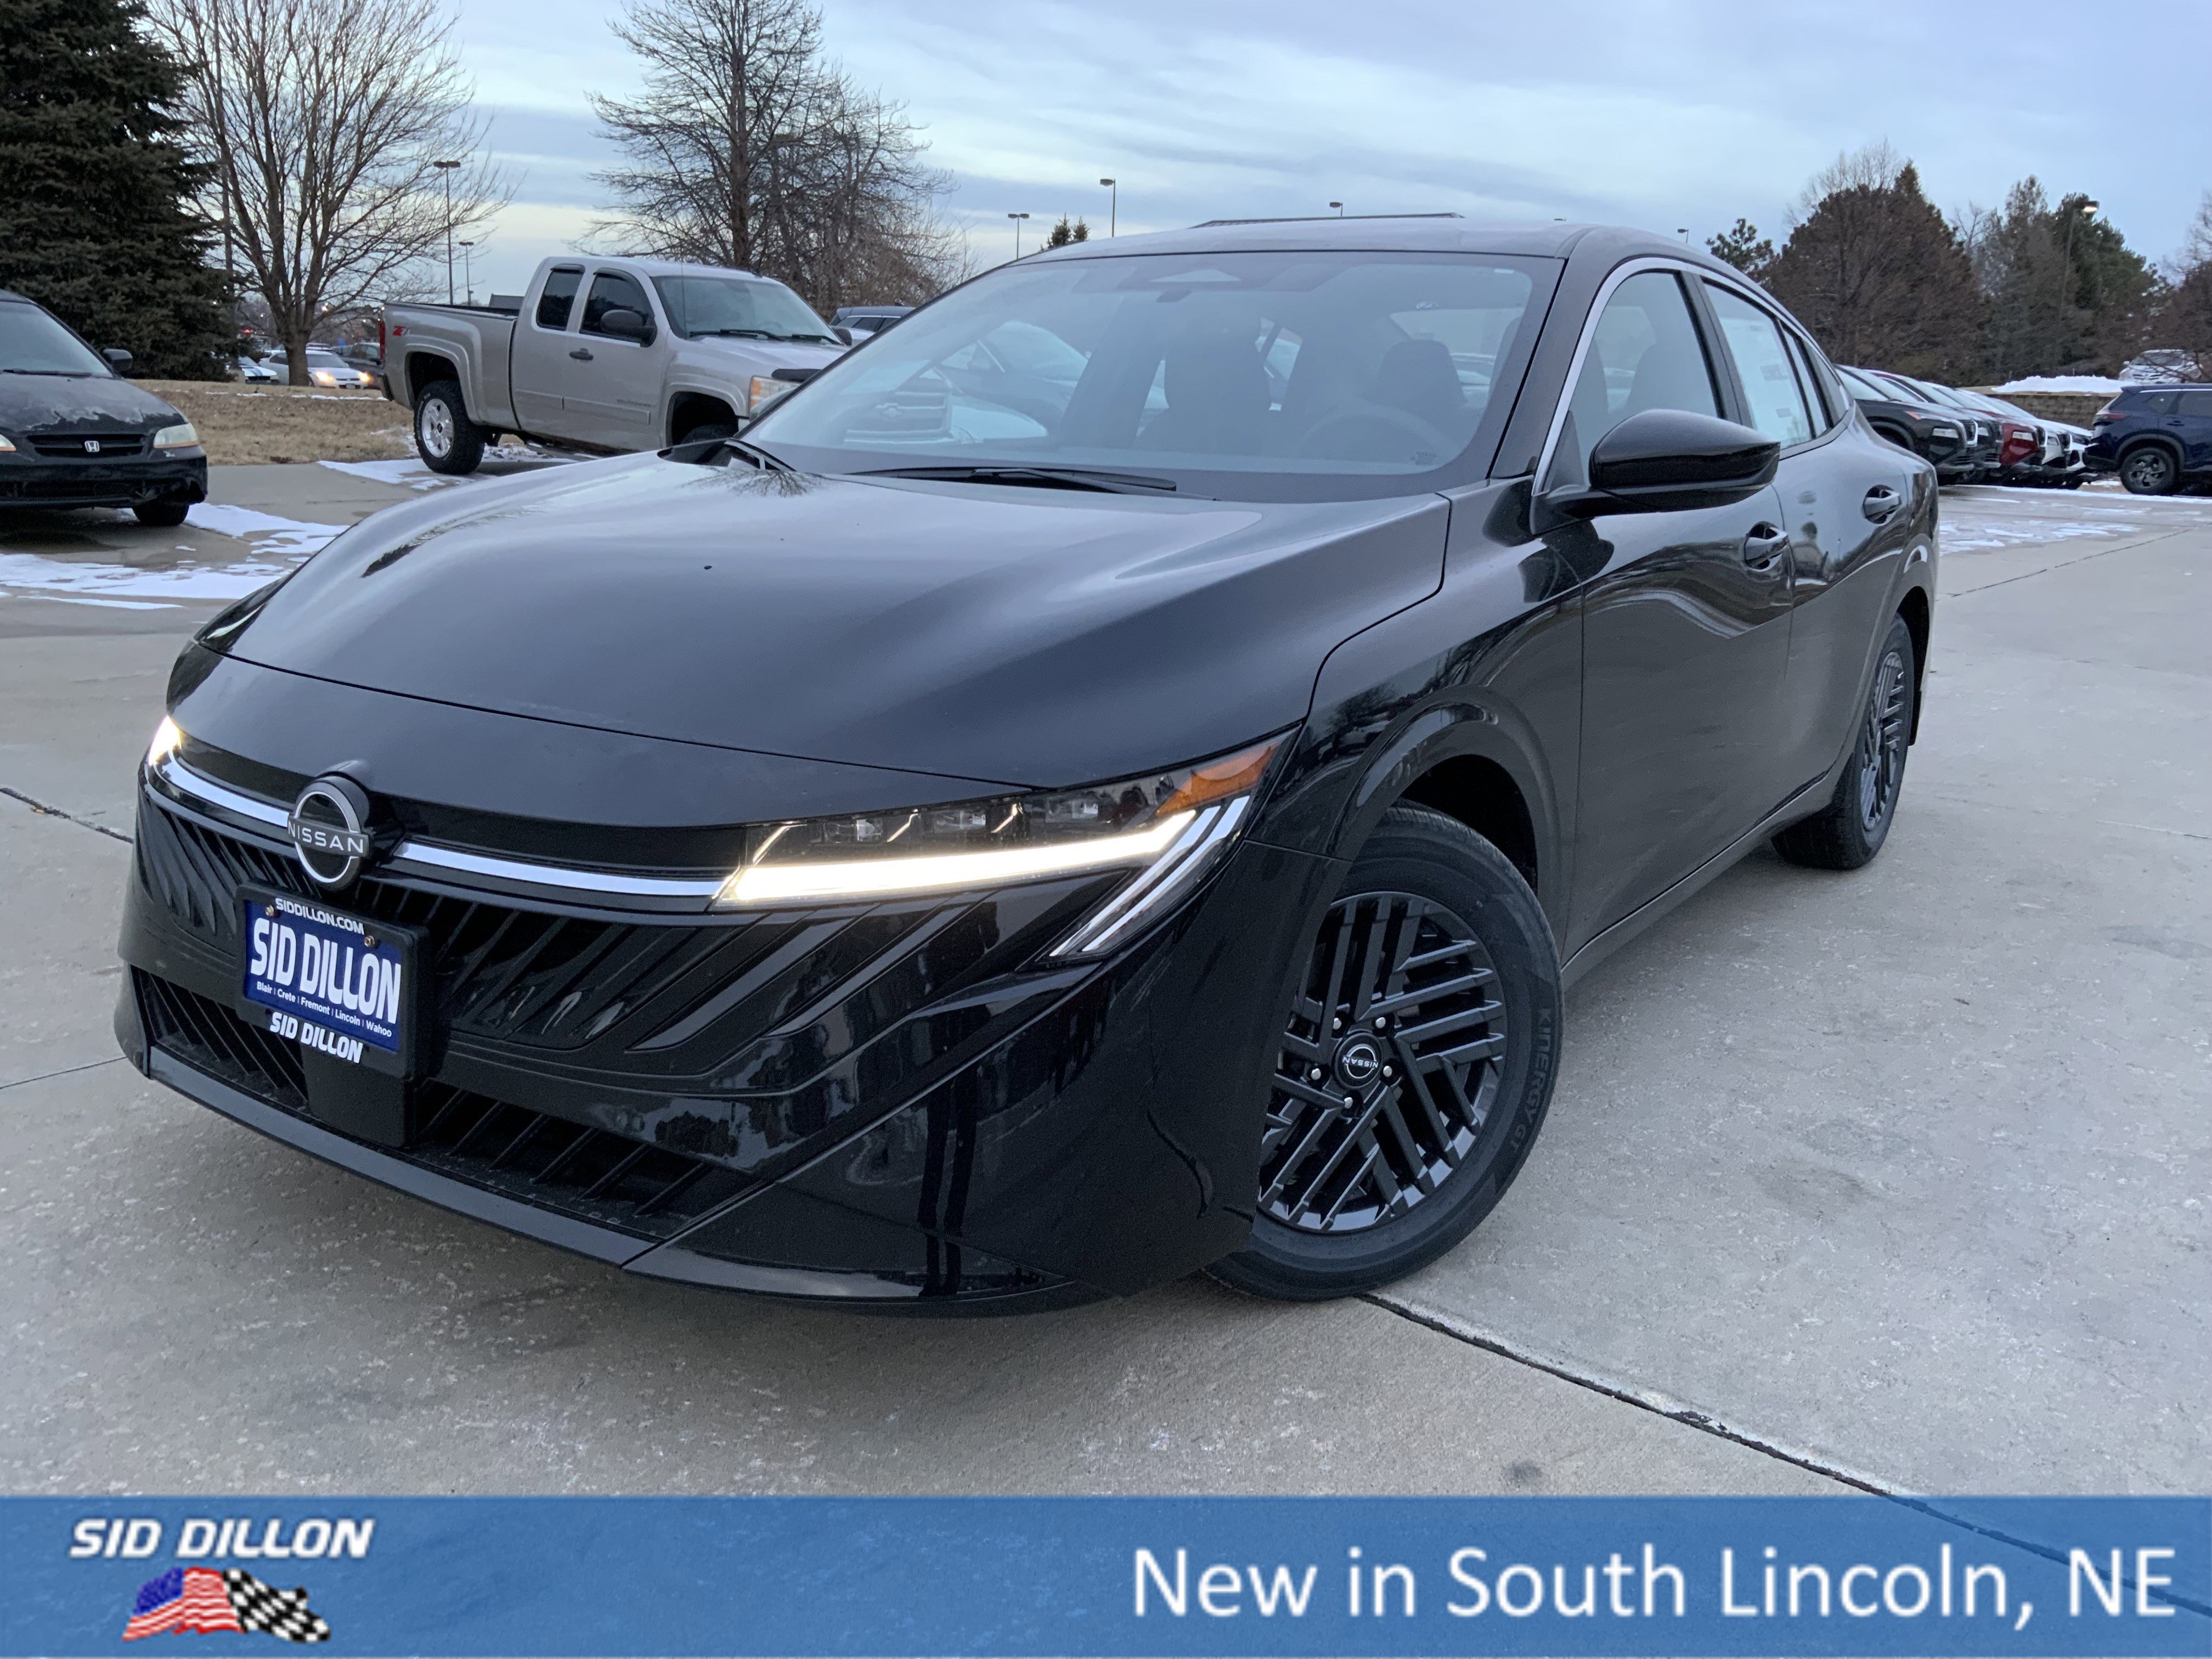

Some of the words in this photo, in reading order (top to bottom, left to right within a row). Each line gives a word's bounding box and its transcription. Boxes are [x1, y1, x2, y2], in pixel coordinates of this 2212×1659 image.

[288, 821, 363, 853] NISSAN
[275, 898, 365, 935] SIDDILLON.COM
[250, 918, 297, 986] SID
[300, 933, 402, 1024] DILLON
[257, 981, 273, 993] Blair
[277, 989, 296, 1002] Crete
[301, 997, 330, 1015] Fremont
[335, 1008, 360, 1026] Lincoln
[366, 1020, 392, 1037] Wahoo
[269, 1012, 298, 1039] SID
[300, 1022, 364, 1064] DILLON
[1342, 1057, 1379, 1068] NISSAN
[1524, 1008, 1551, 1124] KINERGY
